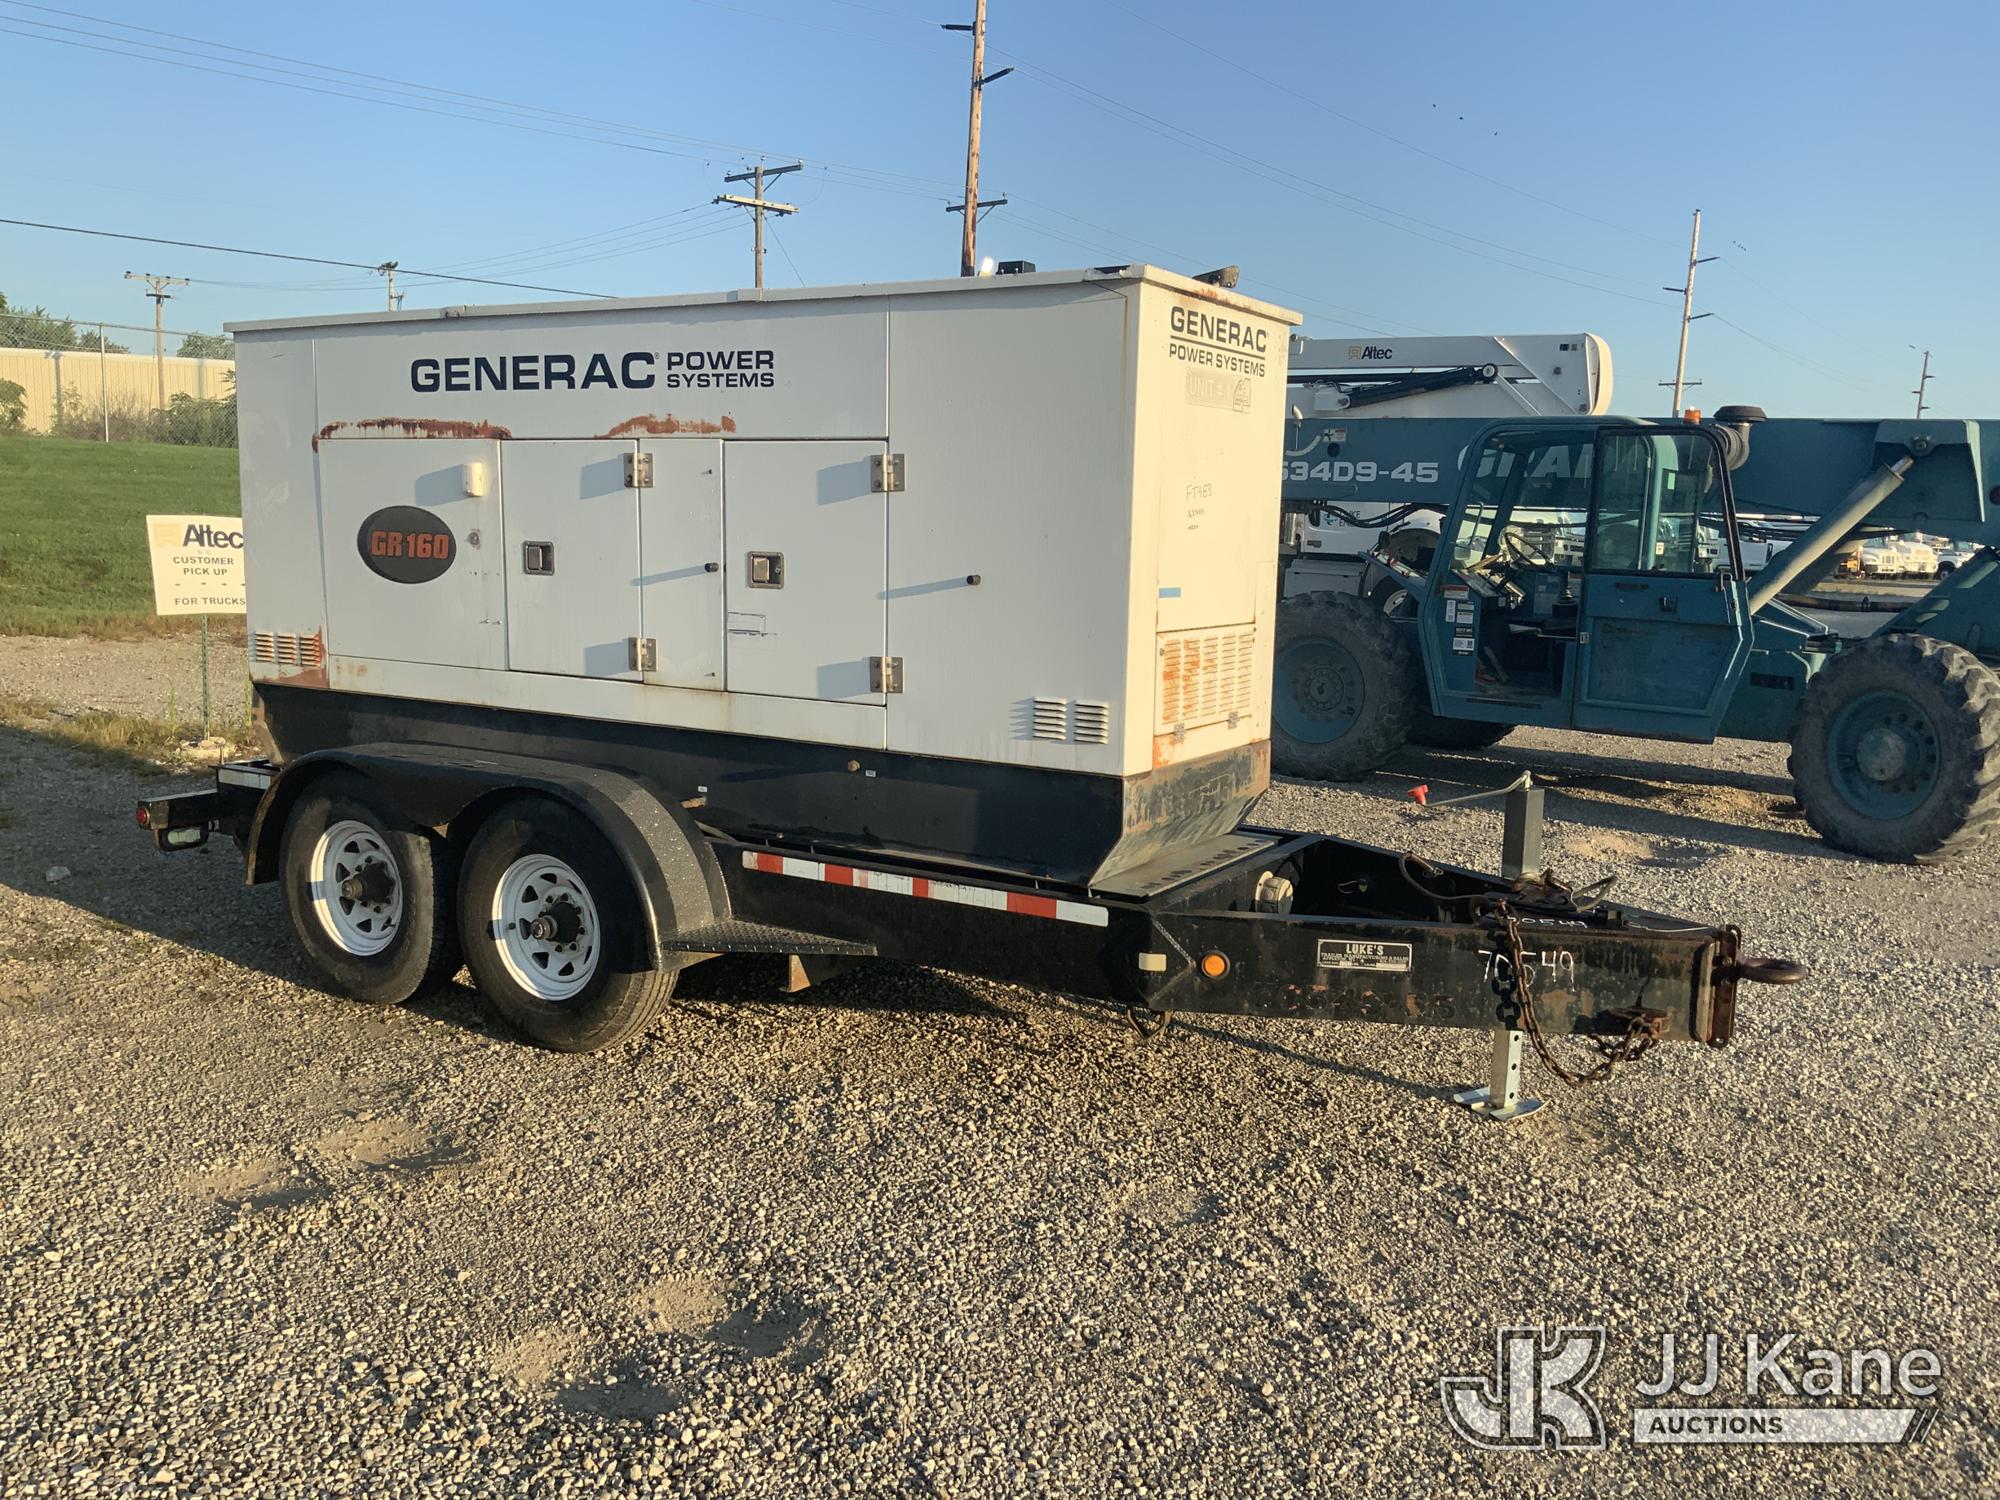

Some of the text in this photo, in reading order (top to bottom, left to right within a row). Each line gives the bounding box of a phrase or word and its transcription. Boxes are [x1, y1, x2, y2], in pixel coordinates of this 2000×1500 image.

[1170, 305, 1267, 353] GENERAC
[667, 350, 774, 370] POWER
[1169, 343, 1266, 377] POWER SYSTEMS
[1361, 345, 1393, 359] Altec
[411, 351, 655, 393] GENERAC
[667, 372, 775, 389] SYSTEMS
[182, 523, 243, 549] Altec
[173, 556, 234, 565] CUSTOMER
[183, 567, 228, 576] PICK UP
[174, 597, 246, 605] FOR TRUCKS
[1346, 943, 1384, 956] LUKE'S
